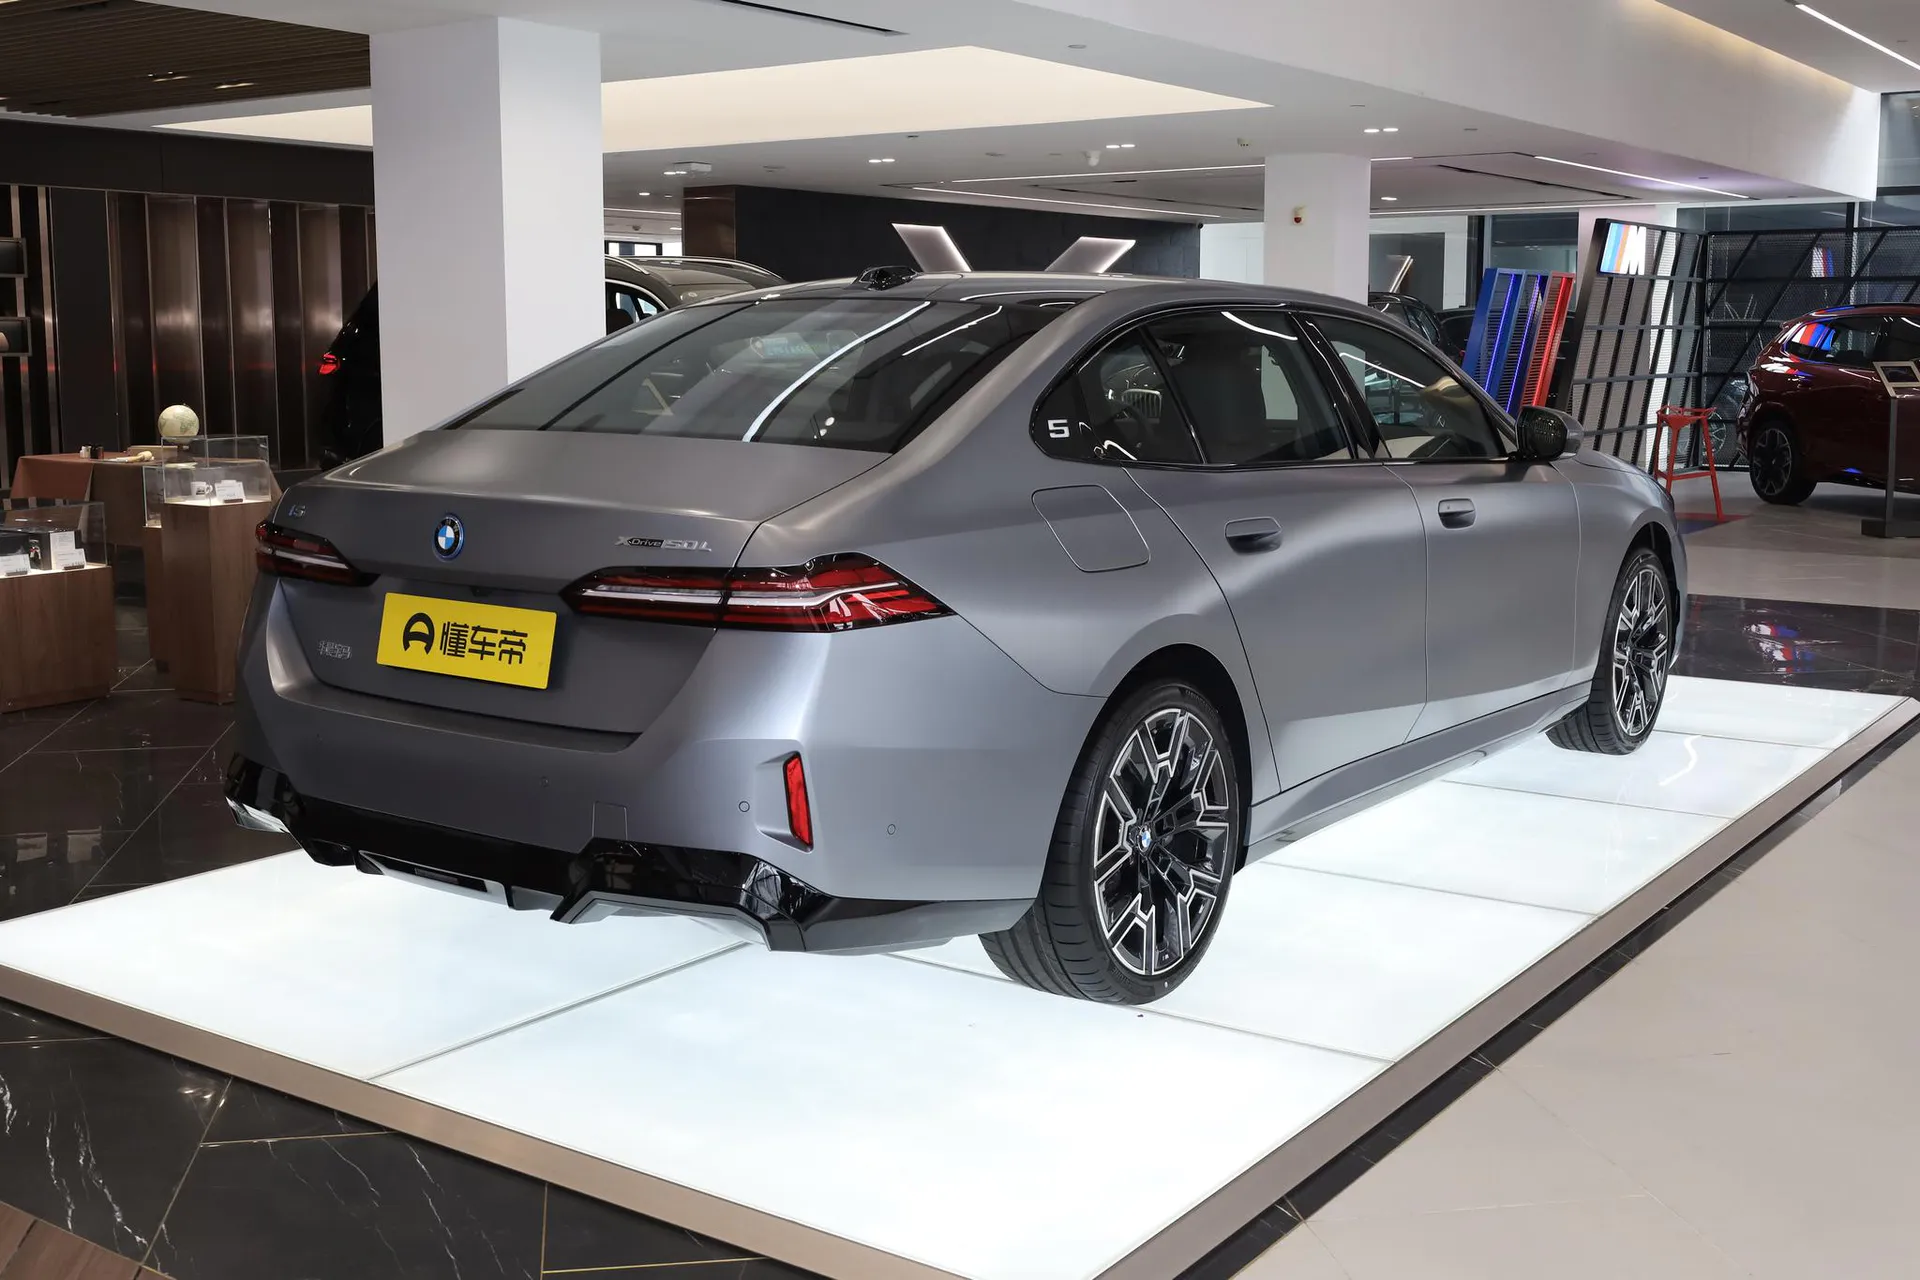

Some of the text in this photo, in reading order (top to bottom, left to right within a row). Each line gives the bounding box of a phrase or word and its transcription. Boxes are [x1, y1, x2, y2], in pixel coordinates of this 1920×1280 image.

[1047, 419, 1070, 438] 5
[440, 621, 528, 665] 懂车帝
